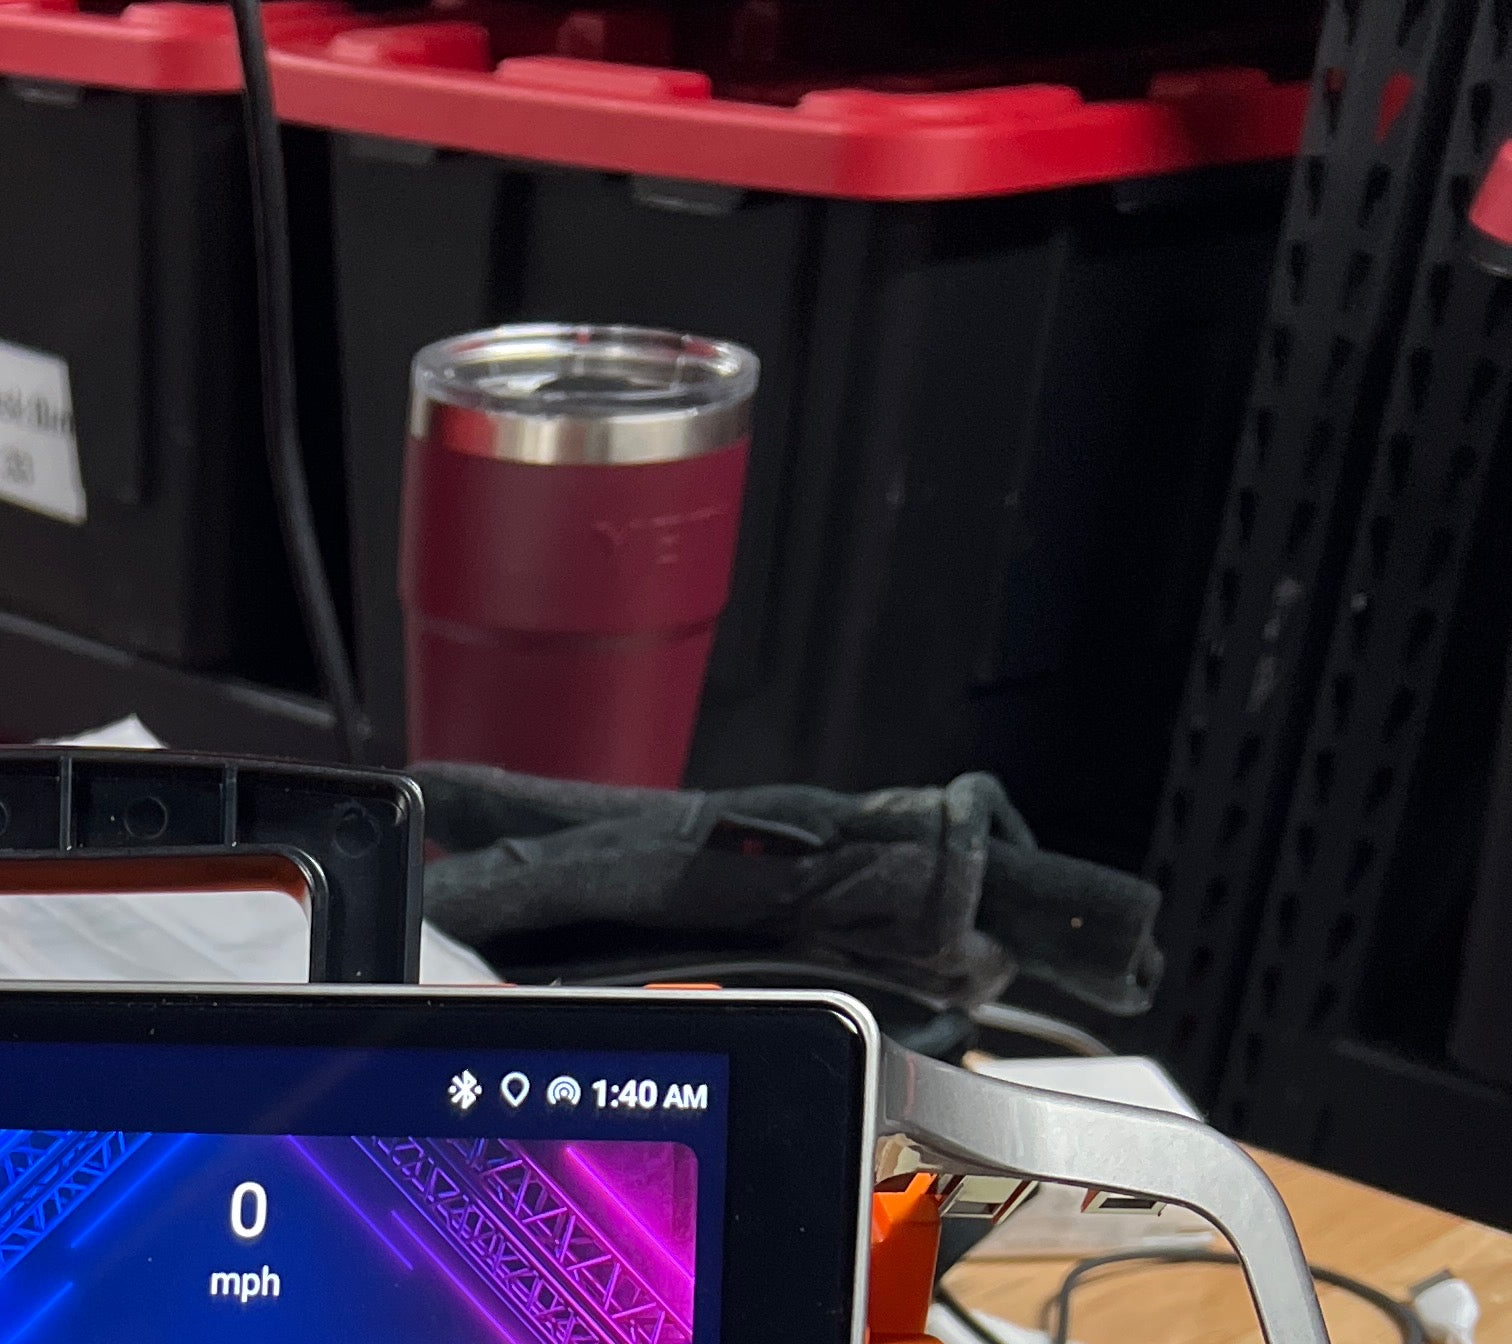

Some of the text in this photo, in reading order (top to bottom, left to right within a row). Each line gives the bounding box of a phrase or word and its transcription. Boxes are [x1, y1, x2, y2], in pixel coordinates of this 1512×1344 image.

[591, 1078, 708, 1110] 1:40 AM
[230, 1181, 269, 1239] 0
[210, 1266, 281, 1305] mph
